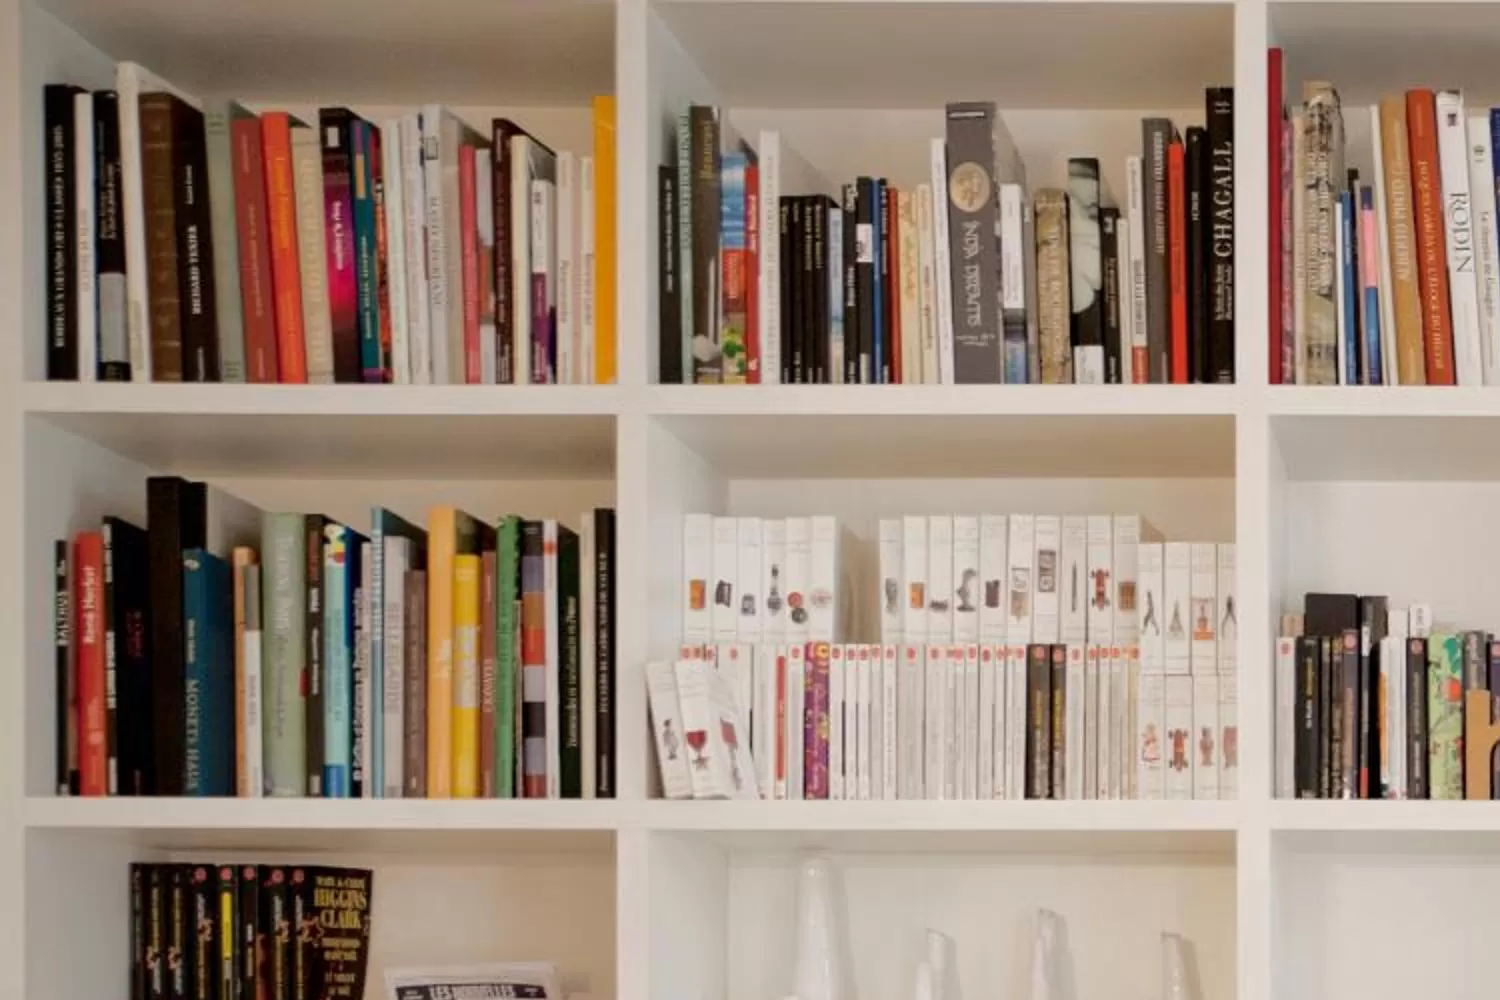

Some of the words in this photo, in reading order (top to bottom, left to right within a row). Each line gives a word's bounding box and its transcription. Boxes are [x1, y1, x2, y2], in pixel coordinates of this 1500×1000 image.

[1213, 142, 1232, 257] CHAGALL
[1392, 177, 1406, 218] PINTO
[1395, 222, 1411, 280] ALBERTO
[1450, 191, 1472, 274] RODIN
[314, 888, 367, 910] HIGGINS
[320, 909, 361, 928] CLARK
